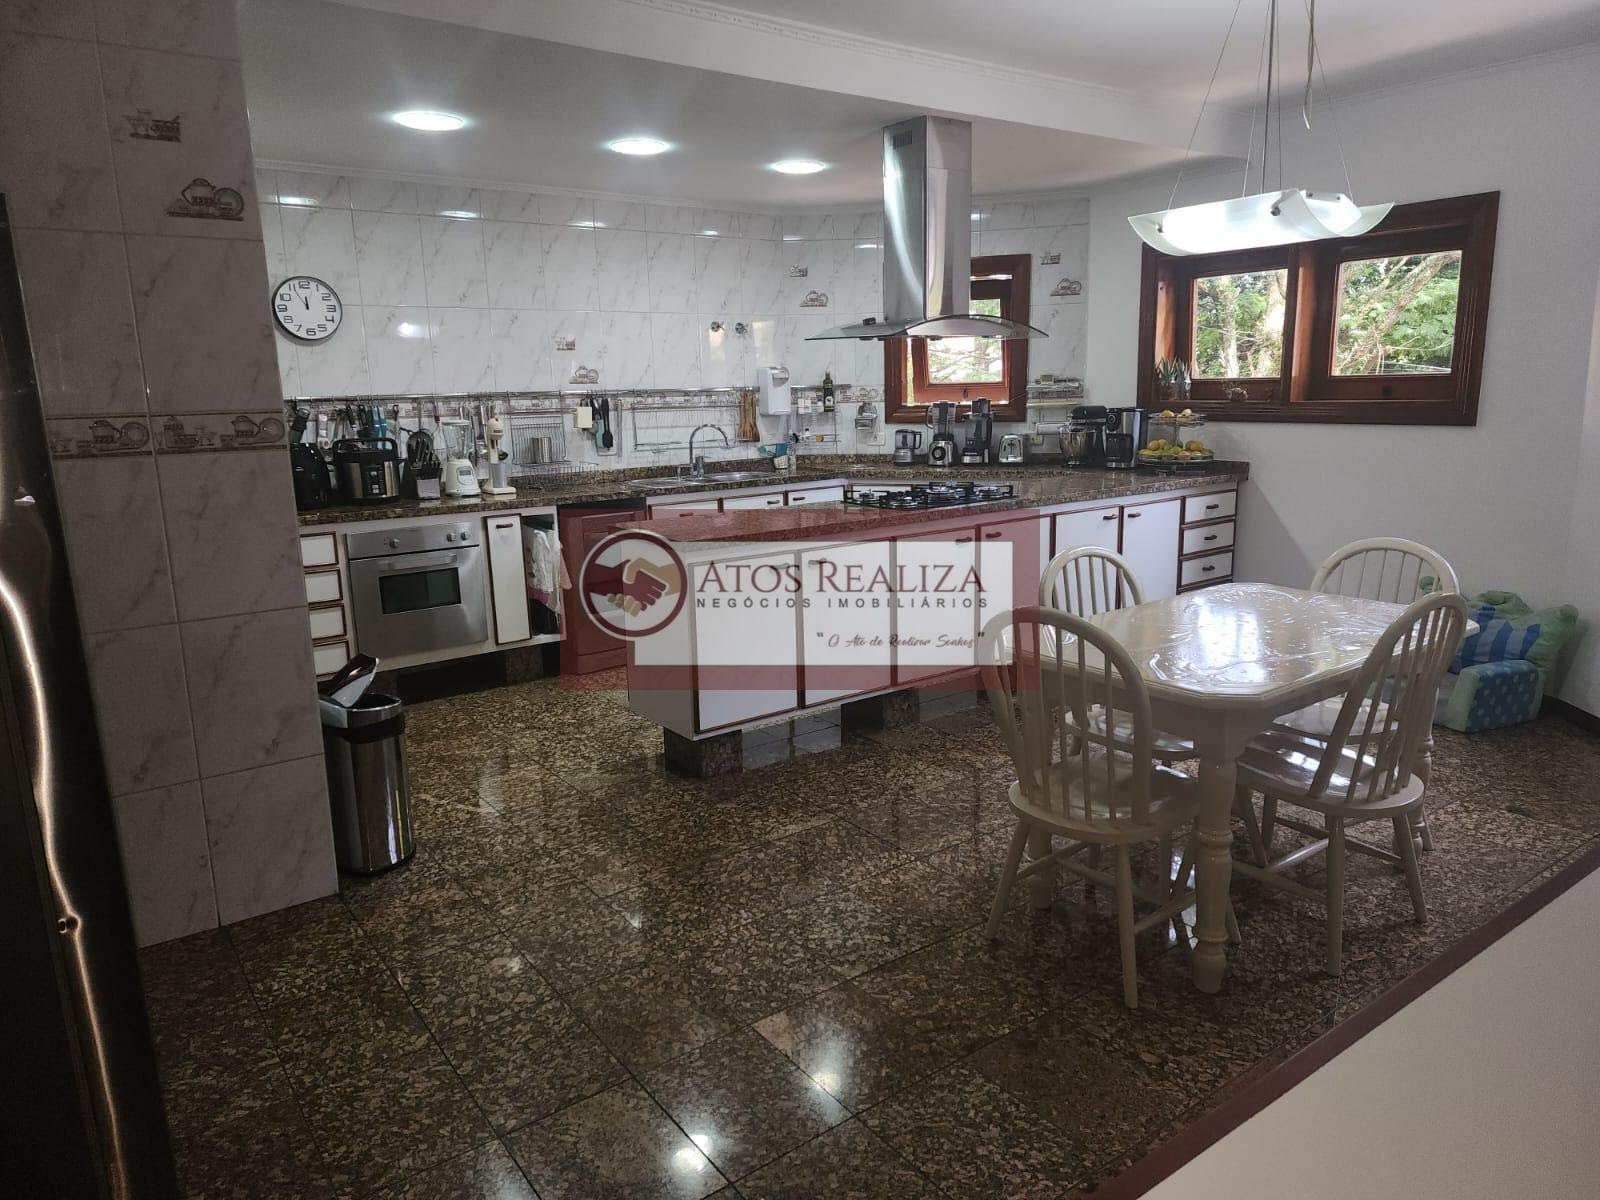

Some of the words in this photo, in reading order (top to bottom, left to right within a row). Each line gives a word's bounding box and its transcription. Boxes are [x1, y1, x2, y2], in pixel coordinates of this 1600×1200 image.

[298, 281, 311, 289] 12
[279, 293, 292, 302] 10
[320, 293, 332, 301] 2
[277, 304, 288, 312] 9
[325, 304, 337, 312] 3
[283, 315, 294, 323] 8
[325, 315, 335, 323] 4
[293, 324, 303, 332] 7
[317, 323, 328, 332] 5
[306, 328, 317, 336] 6
